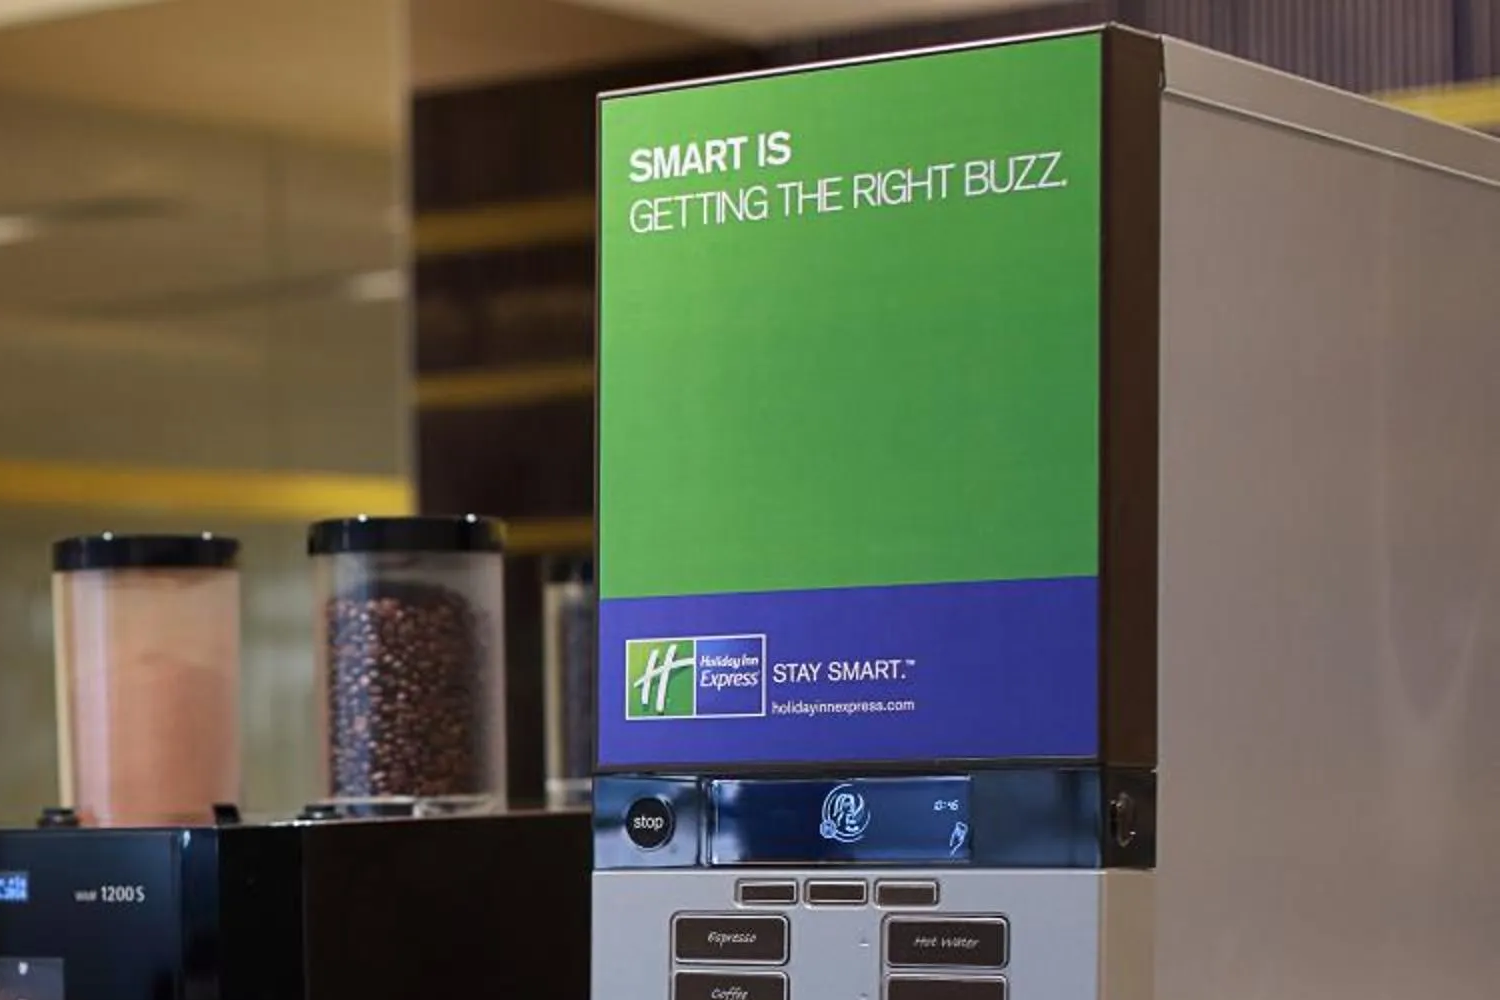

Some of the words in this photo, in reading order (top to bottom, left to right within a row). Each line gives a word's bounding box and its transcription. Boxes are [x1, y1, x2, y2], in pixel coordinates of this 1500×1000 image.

[629, 136, 748, 182] SMART
[758, 131, 791, 167] IS
[629, 185, 768, 233] GETTING
[777, 176, 842, 216] THE
[852, 164, 956, 208] RIGHT
[964, 150, 1068, 196] BUZZ.
[699, 653, 740, 669] Holiday
[741, 652, 759, 666] Inn
[699, 669, 760, 692] Express
[772, 662, 822, 683] STAY
[771, 700, 915, 717] holidayinnexpress.com
[633, 815, 664, 833] stop
[707, 931, 757, 949] Espresso
